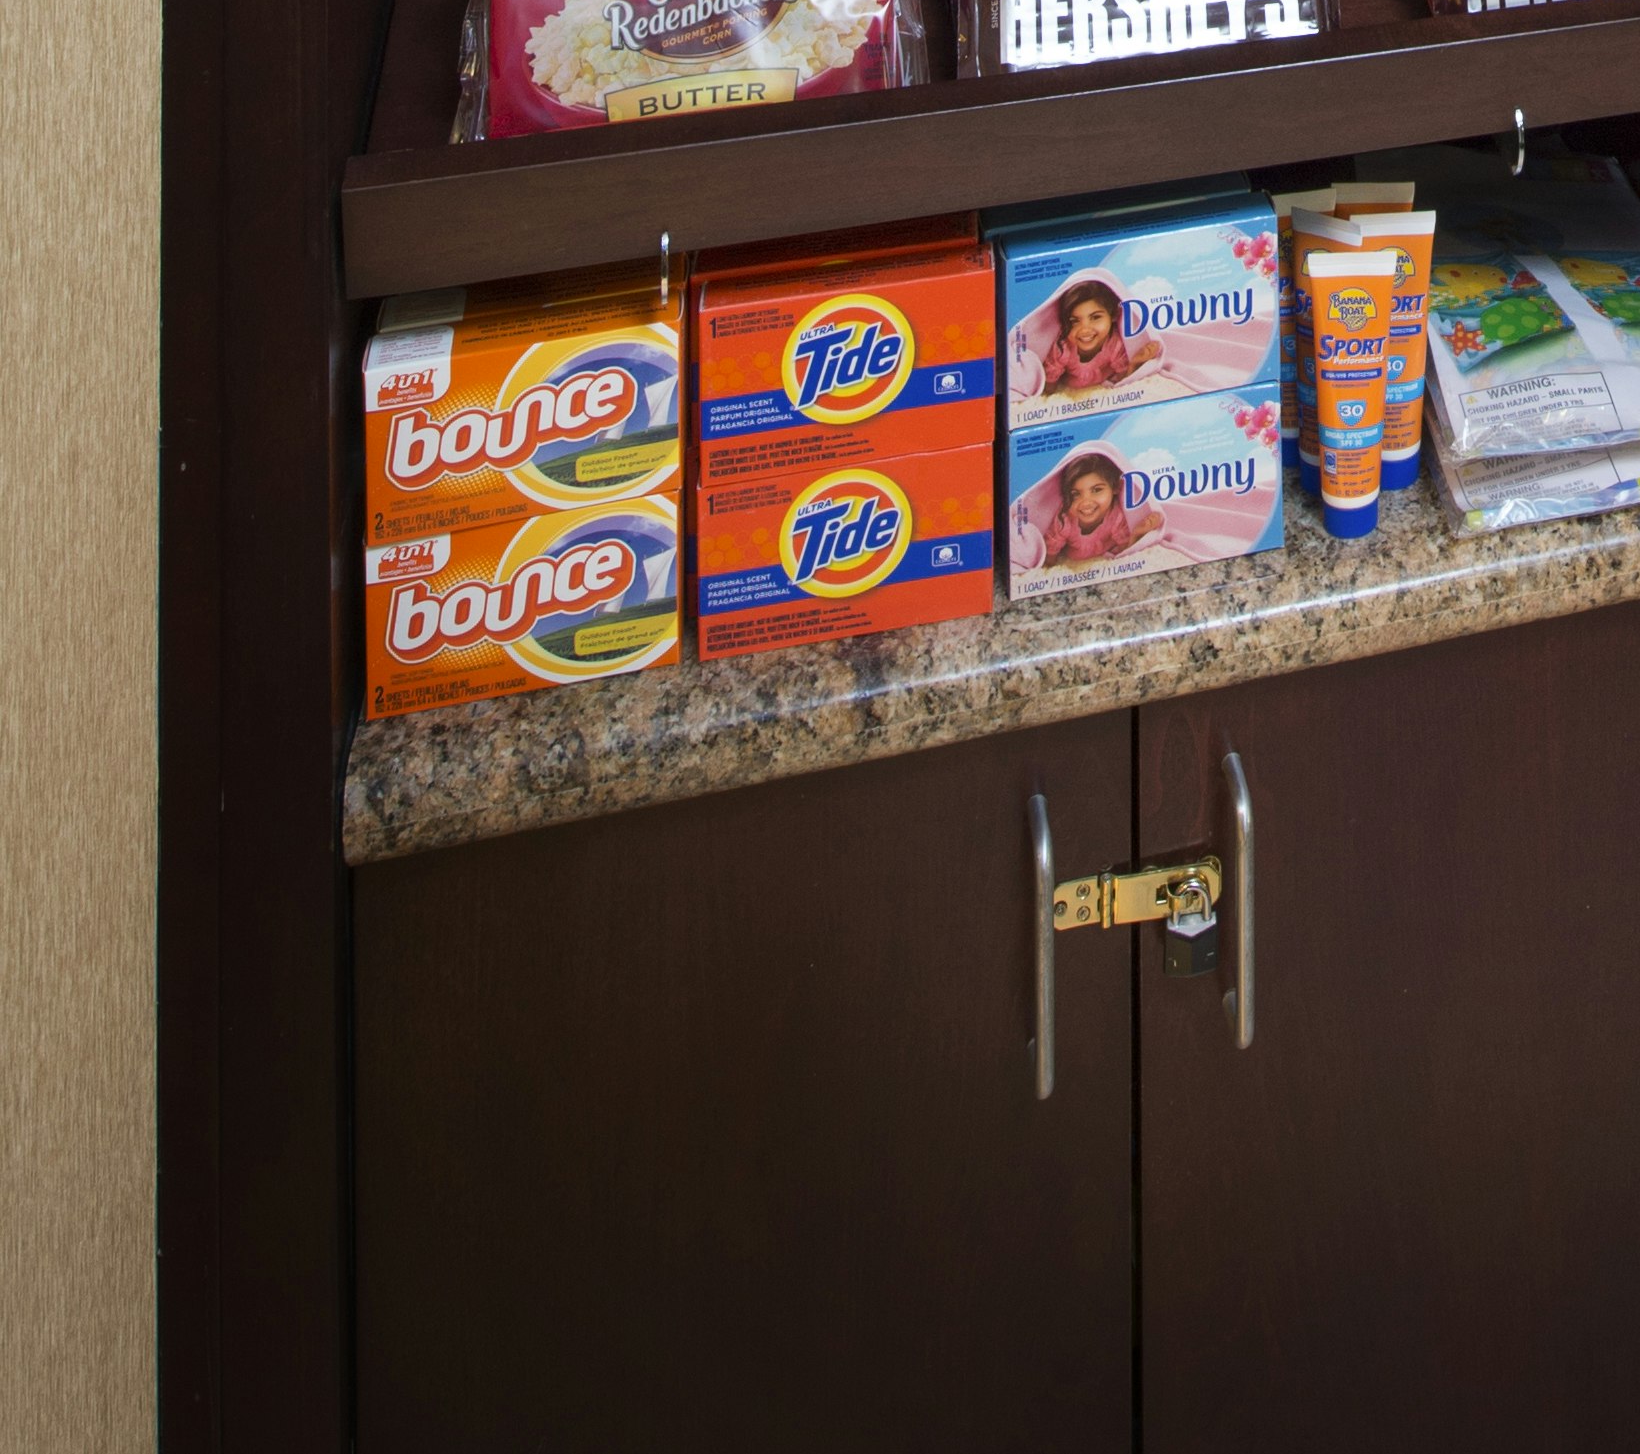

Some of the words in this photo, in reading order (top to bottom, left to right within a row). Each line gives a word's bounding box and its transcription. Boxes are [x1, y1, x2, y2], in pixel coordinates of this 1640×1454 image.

[638, 83, 766, 119] BUTTER
[1119, 288, 1255, 339] Downy
[1150, 295, 1174, 304] ULTRA
[1331, 293, 1372, 306] BANANA
[1339, 306, 1366, 320] BOAT
[799, 324, 835, 341] ULTRA
[1318, 335, 1386, 361] SPORT
[794, 321, 903, 411] Tide
[1467, 402, 1505, 416] CHOKING
[1507, 395, 1540, 408] HAZARD
[1549, 388, 1576, 398] SMALL
[1578, 386, 1604, 395] PARTS
[1487, 376, 1556, 400] WARNING:
[710, 401, 746, 414] ORIGINAL
[748, 398, 773, 410] SCENT
[1340, 405, 1364, 416] 30
[392, 370, 624, 479] bounce
[1121, 458, 1257, 511] Downy
[791, 495, 901, 585] Tide
[392, 542, 622, 651] bounce
